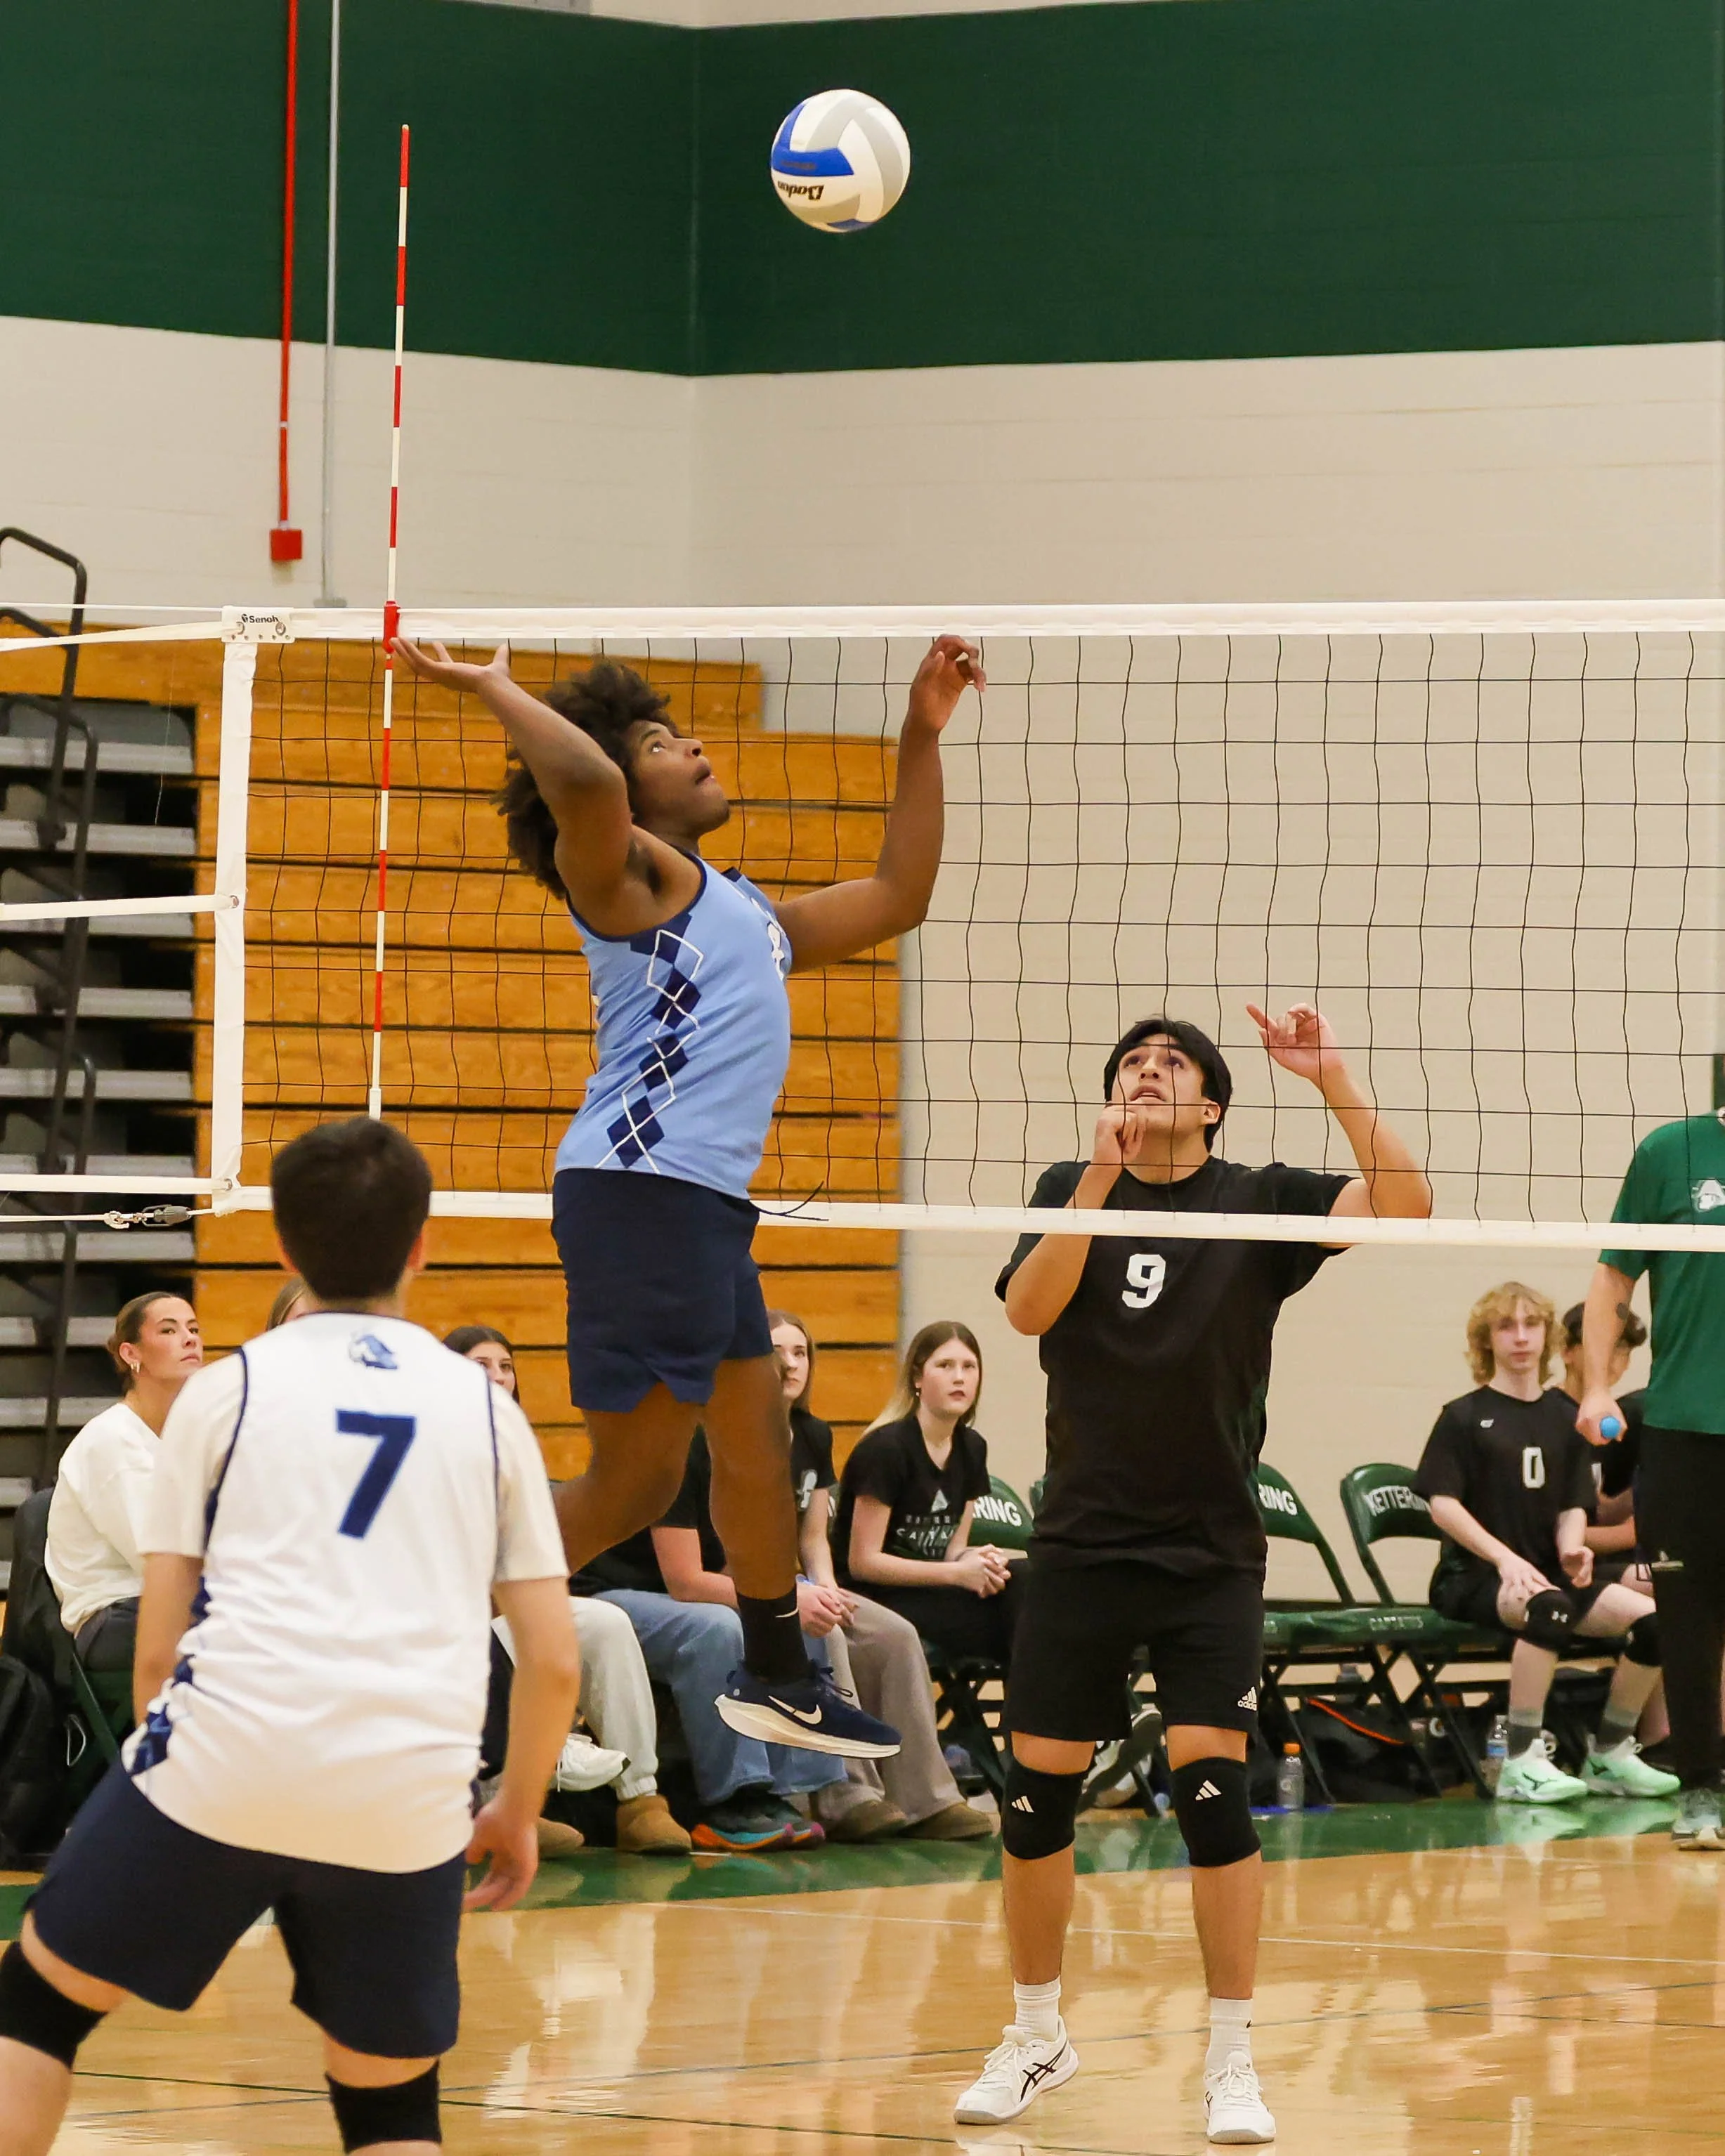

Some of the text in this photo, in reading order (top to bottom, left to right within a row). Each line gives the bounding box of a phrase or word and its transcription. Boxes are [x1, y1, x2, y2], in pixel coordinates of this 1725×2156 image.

[1122, 1253, 1166, 1309] 9
[335, 1409, 417, 1539] 7
[1523, 1446, 1545, 1489] 0
[972, 1495, 1022, 1527] RING
